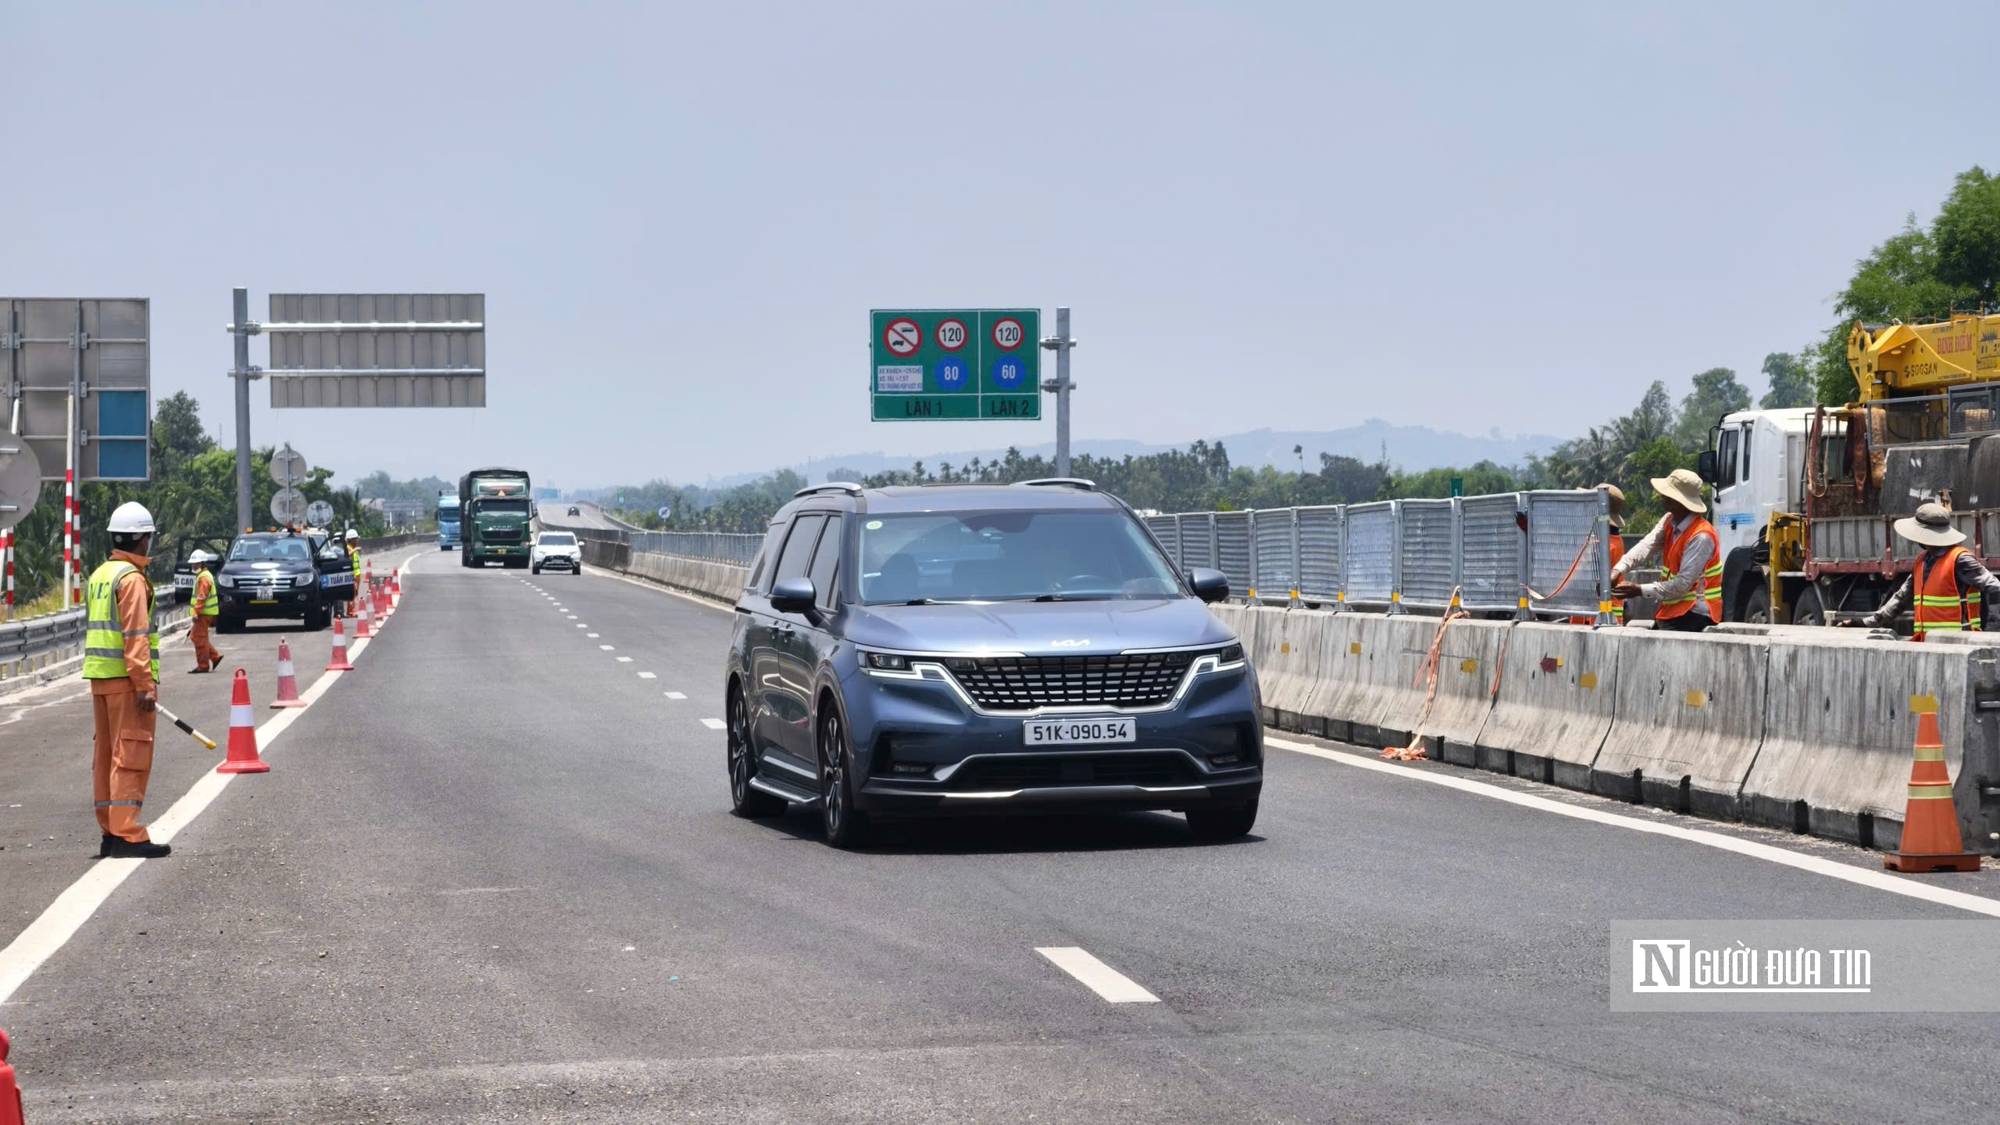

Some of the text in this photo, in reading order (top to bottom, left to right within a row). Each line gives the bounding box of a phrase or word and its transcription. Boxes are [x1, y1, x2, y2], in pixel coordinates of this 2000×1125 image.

[941, 327, 962, 342] 120
[998, 327, 1019, 342] 120
[944, 366, 959, 381] 80
[1001, 364, 1016, 379] 60
[906, 397, 943, 416] LÀN 1
[991, 396, 1030, 416] LÀN 2
[1033, 723, 1127, 741] 51K-090.54
